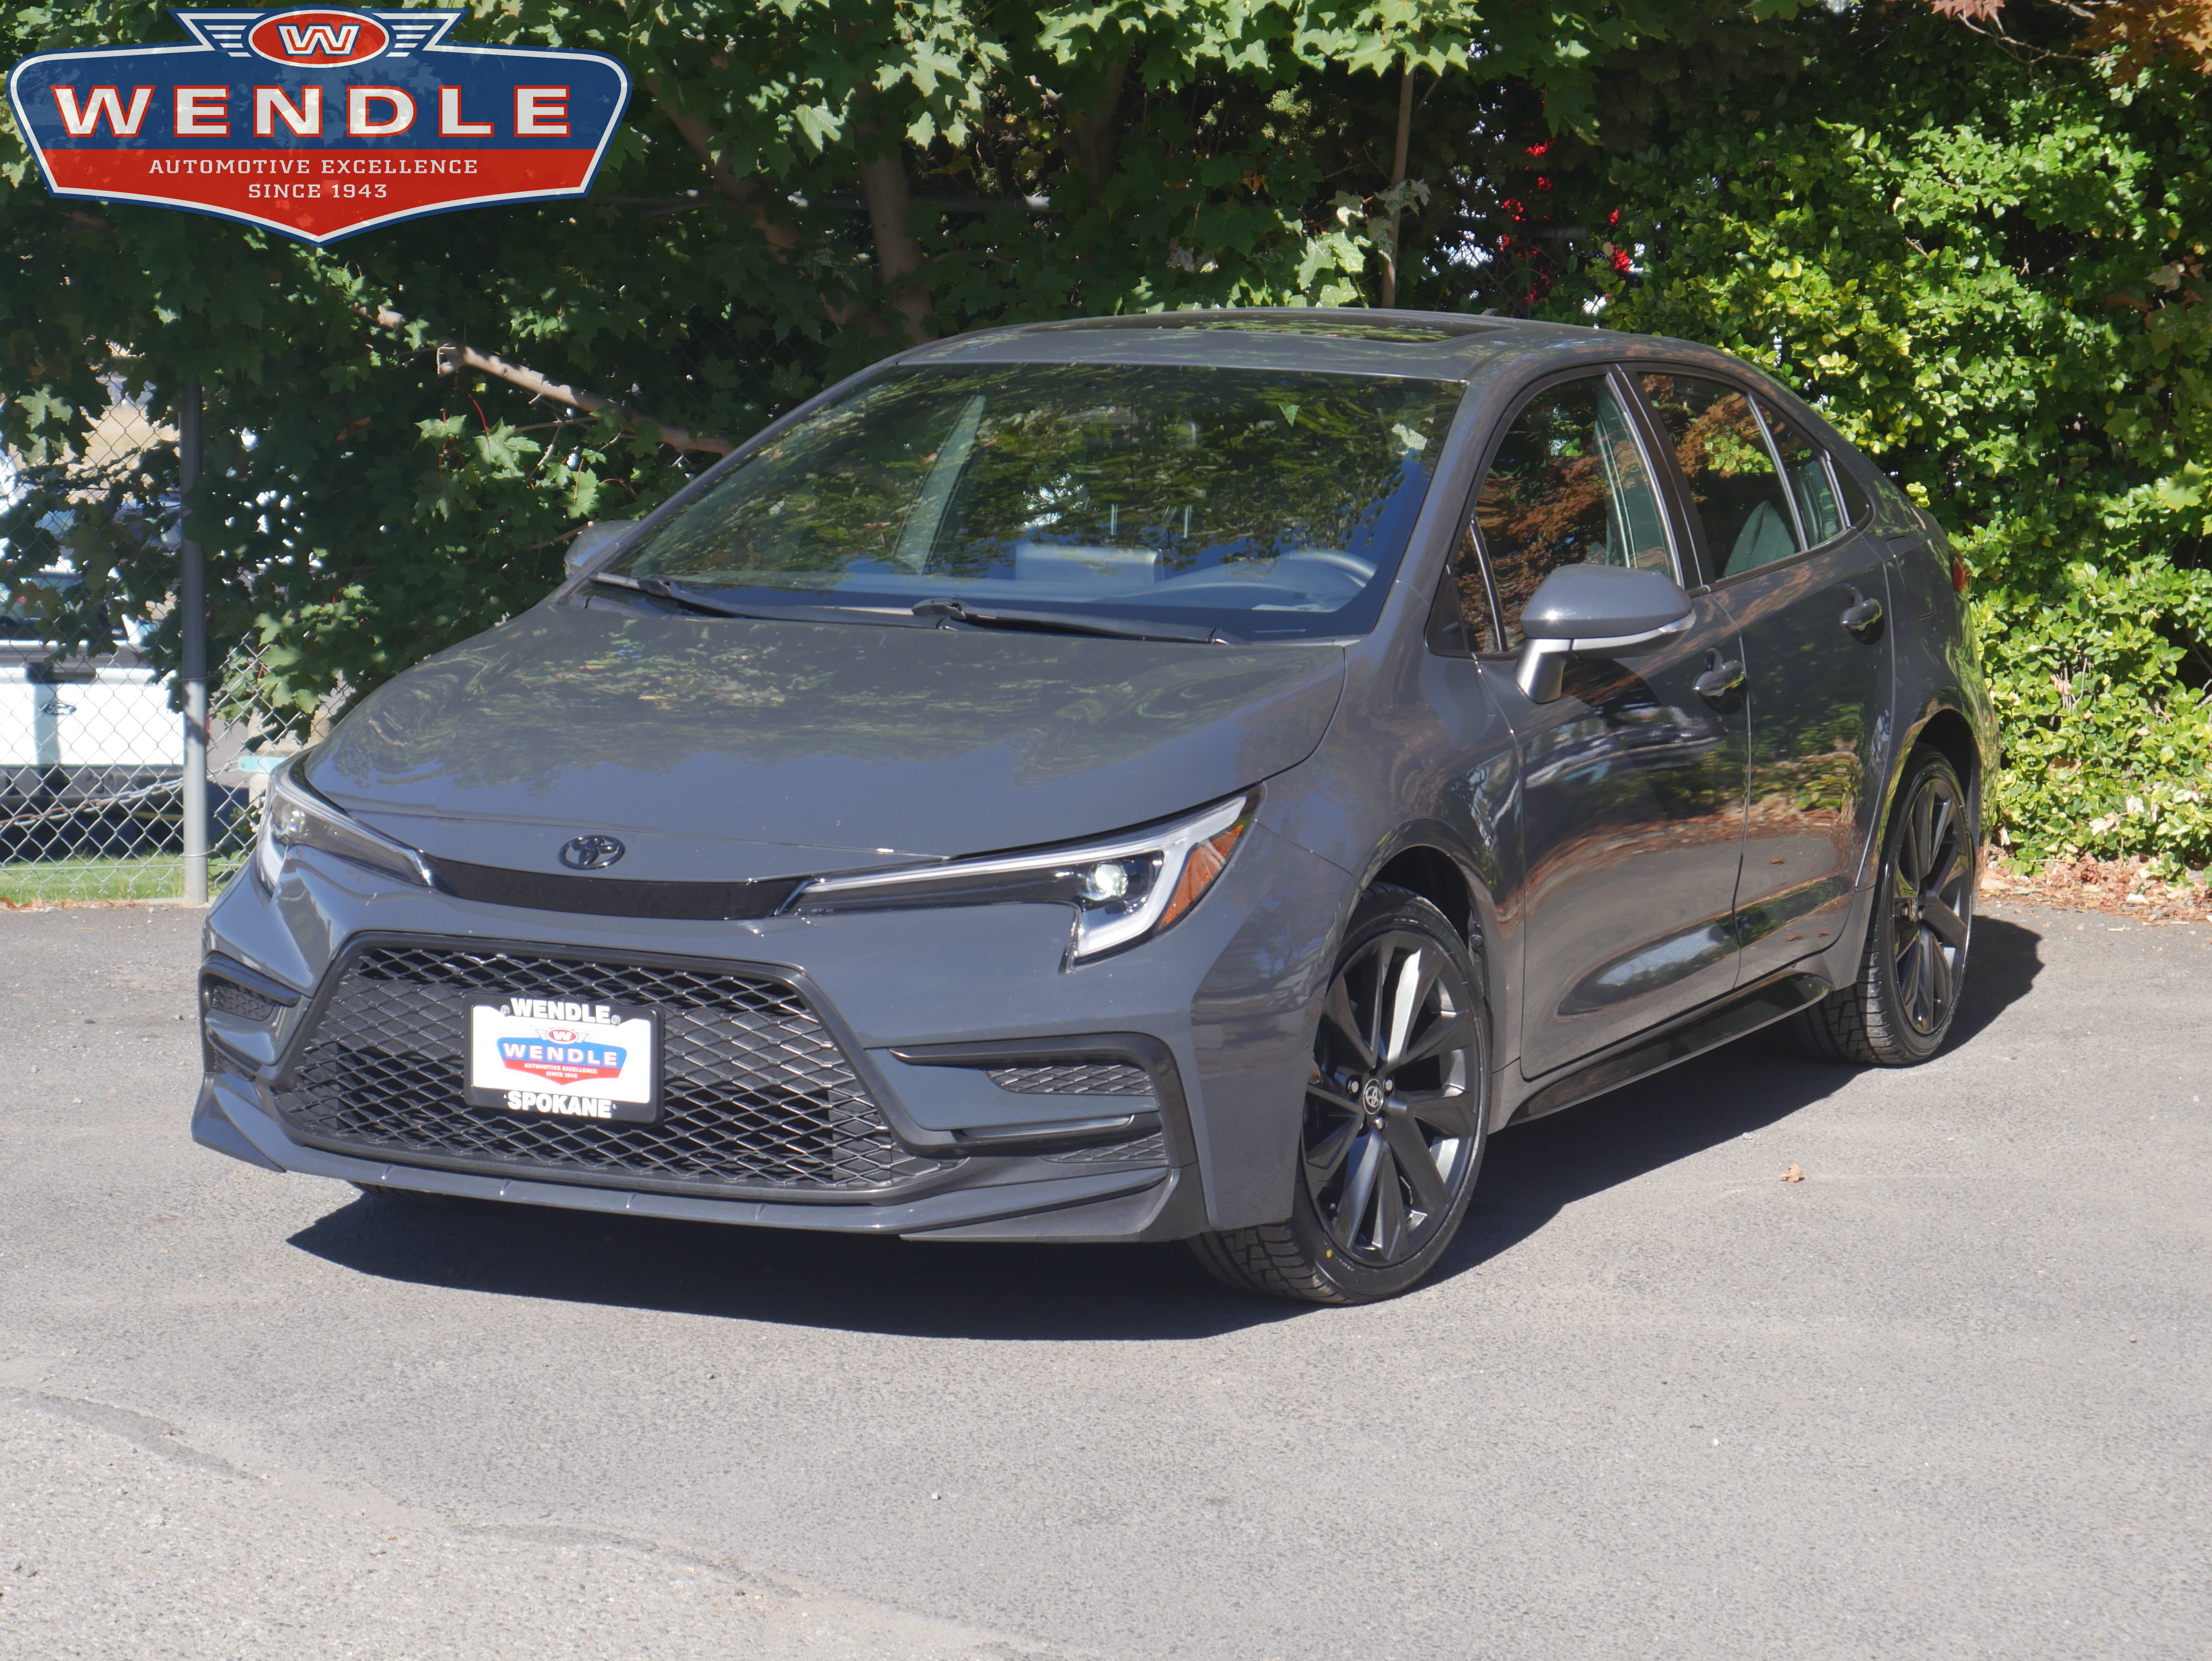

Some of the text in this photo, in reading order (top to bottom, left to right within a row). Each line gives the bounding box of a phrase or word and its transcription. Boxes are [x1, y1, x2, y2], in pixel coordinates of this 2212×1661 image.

[511, 998, 611, 1024] WENDLE
[503, 1042, 617, 1066] WENDLE
[524, 1063, 597, 1074] AUTOMOTIVE EXCELLENCE
[507, 1090, 611, 1118] SPOKANE
